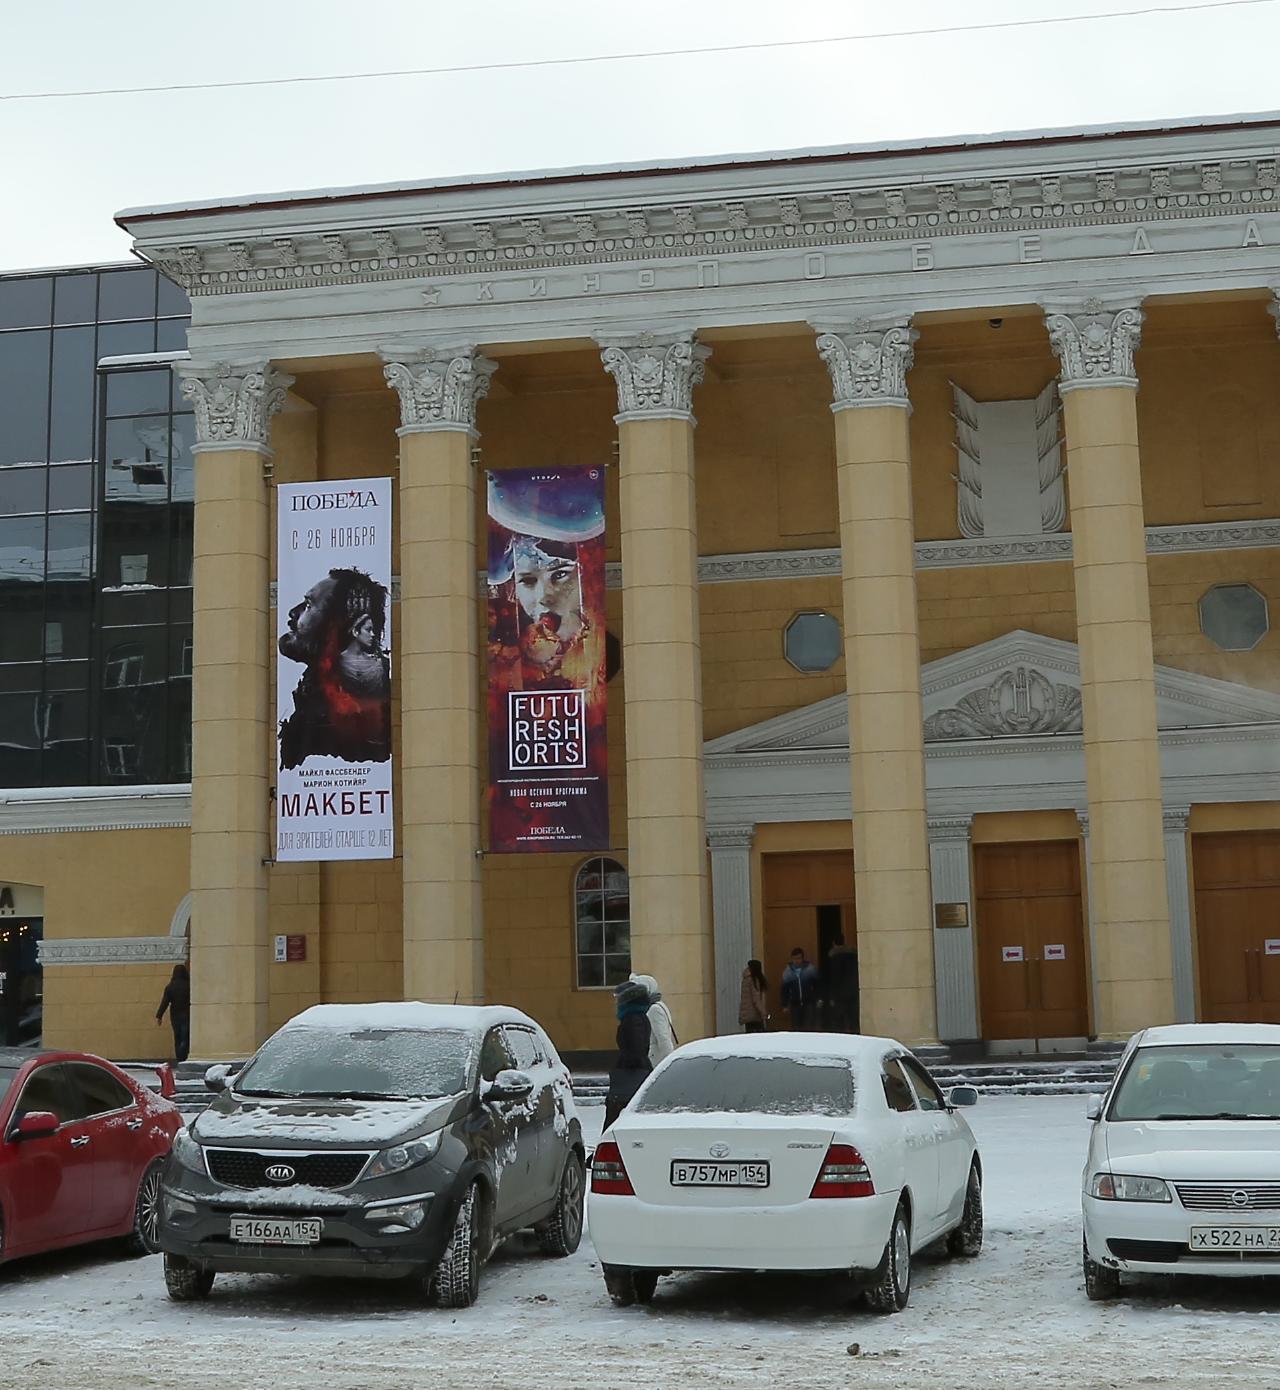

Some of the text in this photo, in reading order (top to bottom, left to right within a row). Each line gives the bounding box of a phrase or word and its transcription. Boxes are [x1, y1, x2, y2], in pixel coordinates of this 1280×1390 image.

[291, 490, 379, 512] ПОБЕДА
[292, 525, 375, 551] С 26 НОЯБРЯ
[515, 695, 579, 719] FUTU
[515, 718, 580, 741] RESH
[514, 741, 579, 764] ORTS
[299, 767, 372, 777] МАЙКЛ ФАССБЕНДЕР
[303, 780, 332, 788] МАРИОН
[281, 790, 390, 817] МАКБЕТ
[278, 832, 294, 851] ДЛЯ
[296, 829, 333, 849] ЗРИТЕЛЕЙ
[336, 829, 366, 849] СТАРШЕ
[378, 829, 392, 848] ЛЕТ
[269, 1167, 292, 1178] KIA
